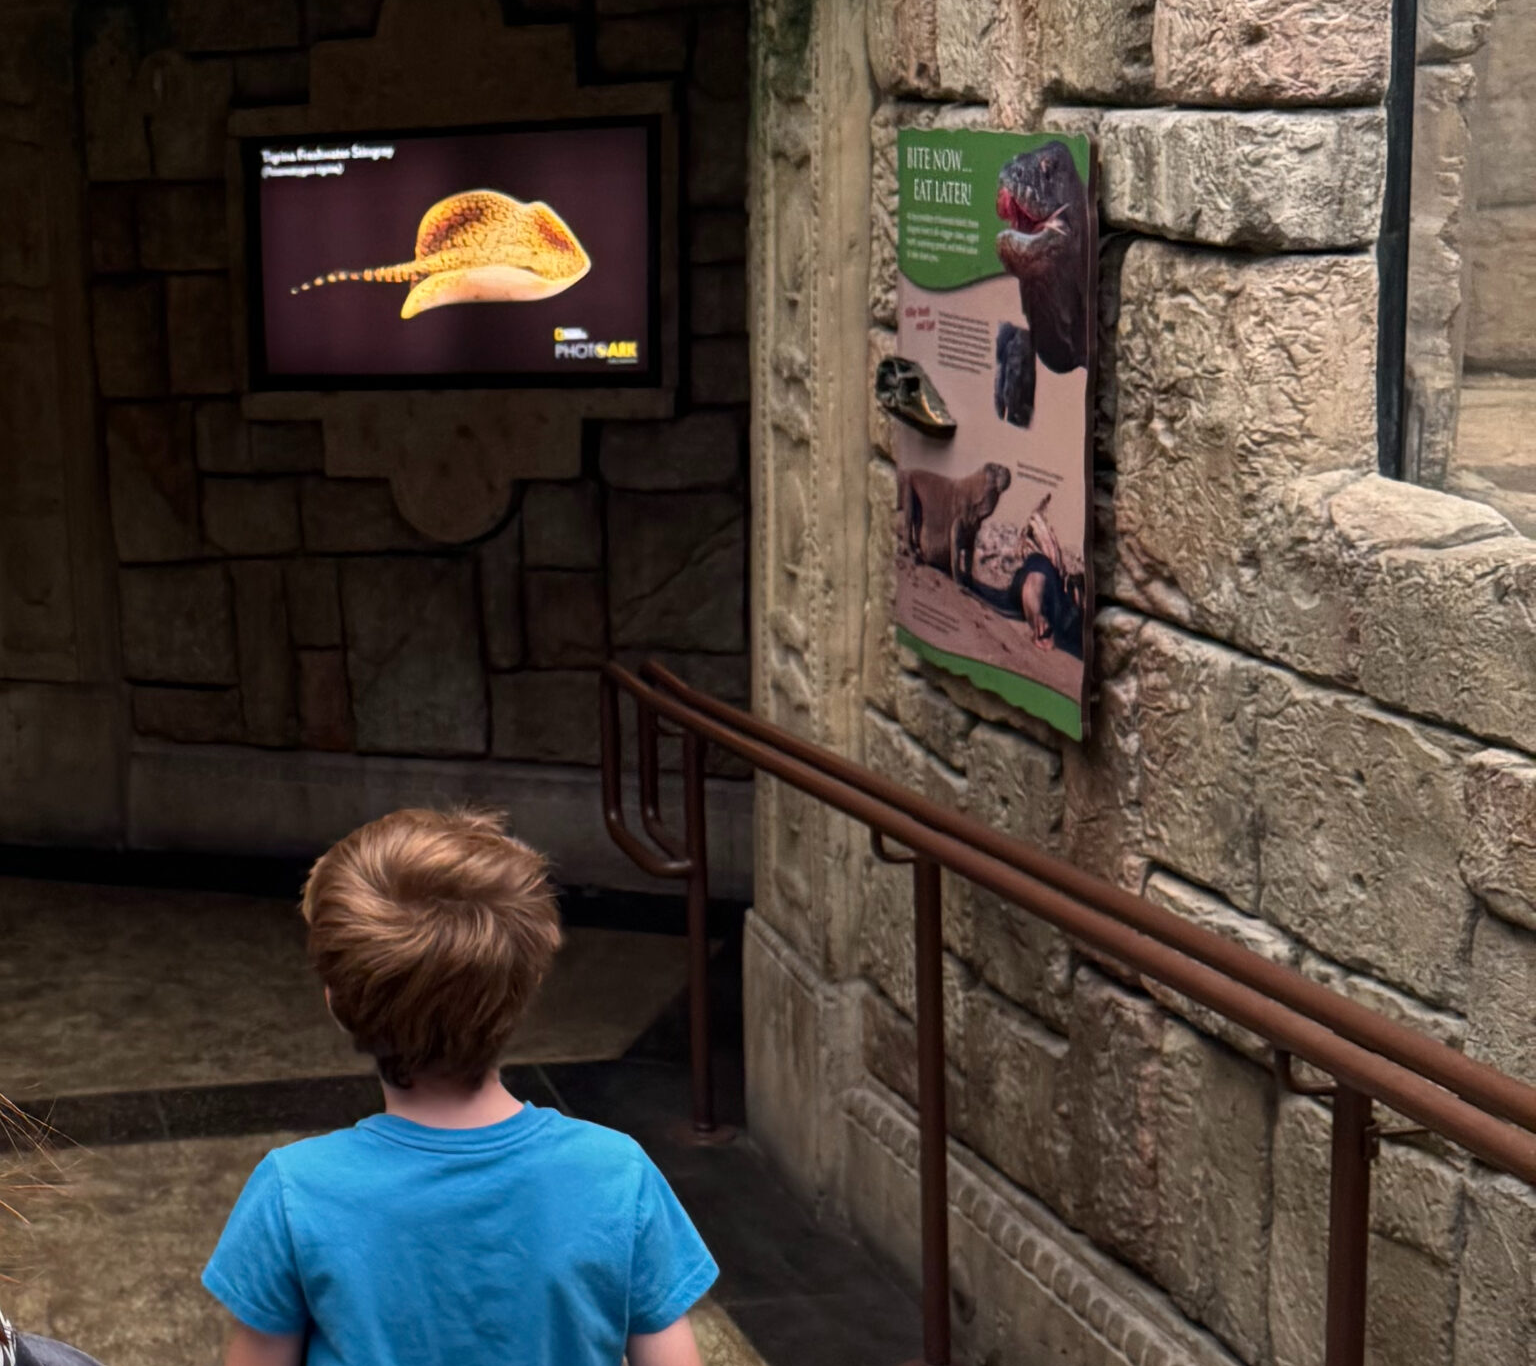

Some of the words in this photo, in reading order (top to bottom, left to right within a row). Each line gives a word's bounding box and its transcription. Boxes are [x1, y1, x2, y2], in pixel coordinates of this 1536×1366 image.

[906, 146, 931, 170] BITE
[914, 178, 933, 202] EAT
[935, 180, 972, 206] LATER!
